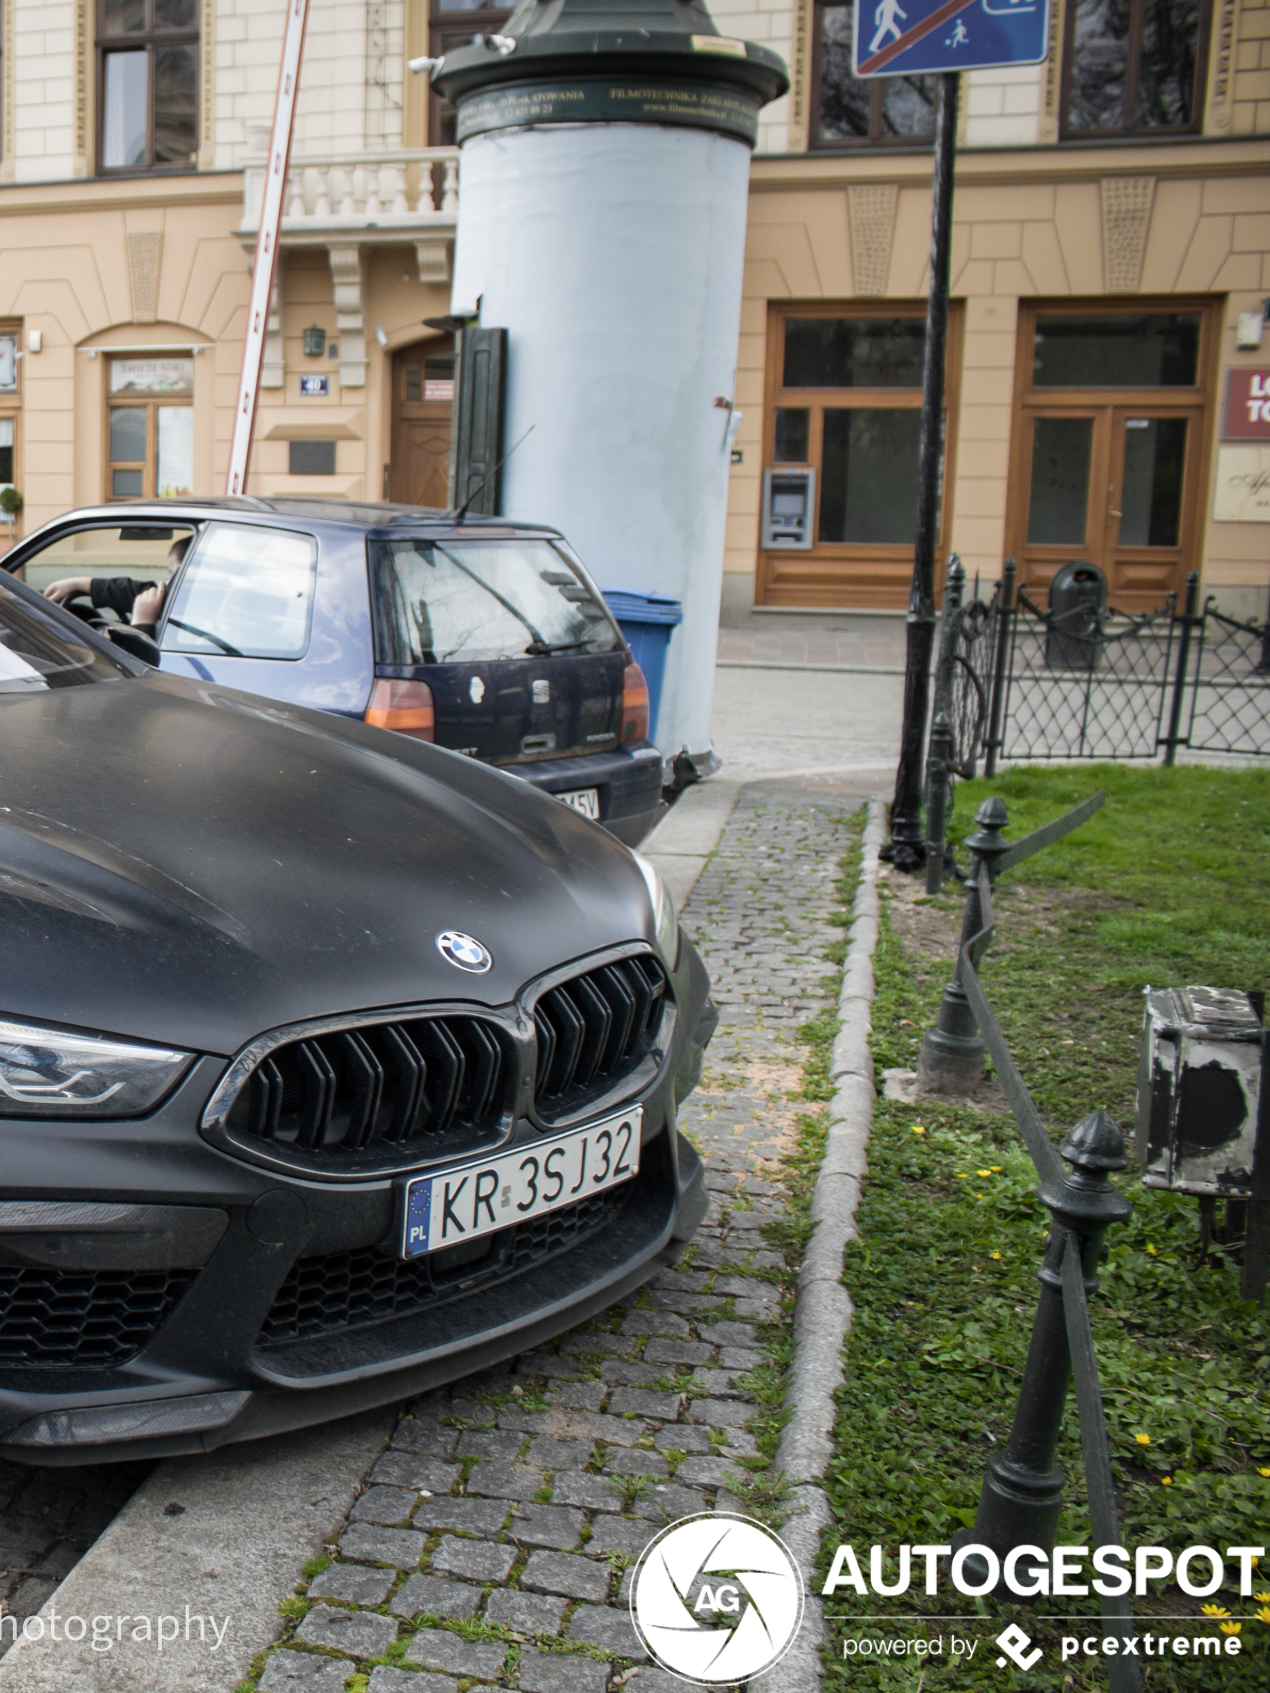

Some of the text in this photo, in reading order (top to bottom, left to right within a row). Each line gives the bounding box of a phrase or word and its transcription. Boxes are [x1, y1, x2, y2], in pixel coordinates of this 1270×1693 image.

[609, 87, 698, 104] FILMOTECHNIKA
[305, 378, 321, 391] 40
[441, 1121, 632, 1238] KR 3SJ32
[410, 1225, 427, 1243] PL
